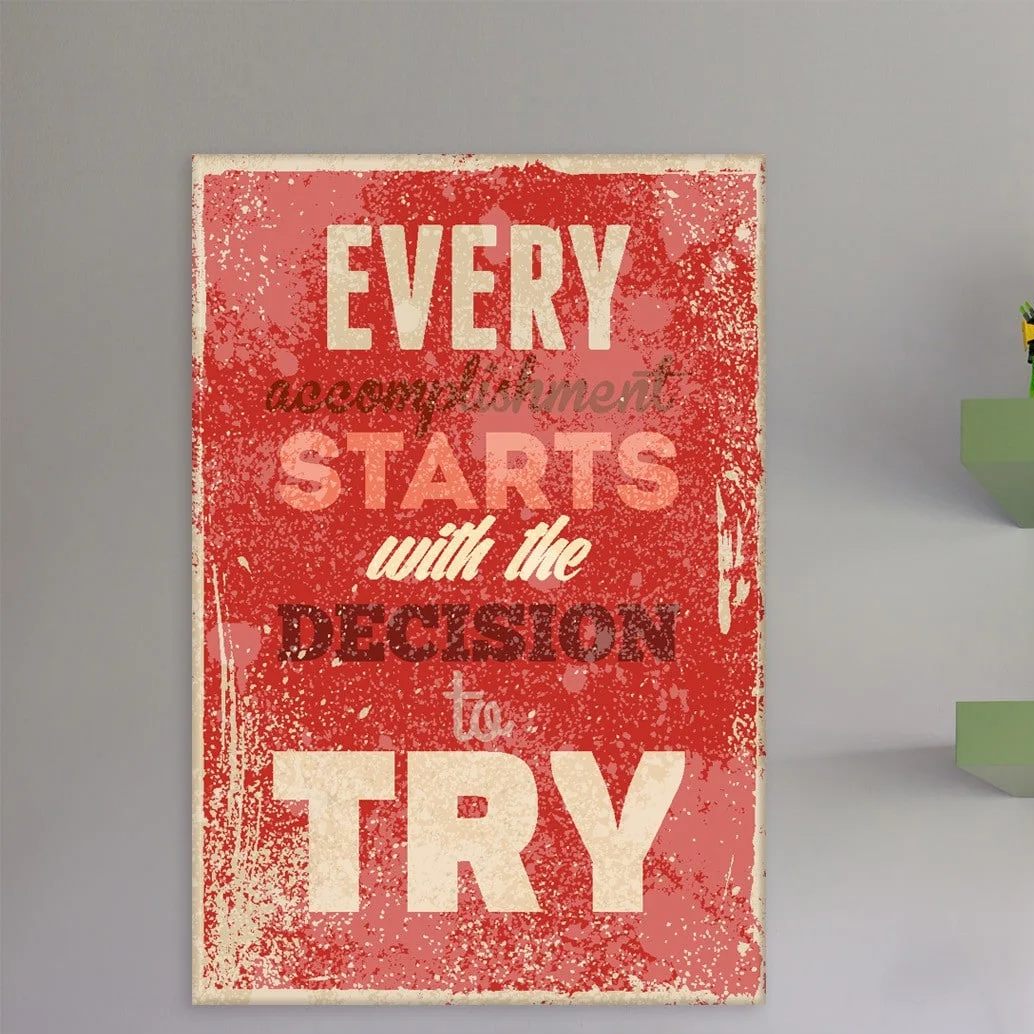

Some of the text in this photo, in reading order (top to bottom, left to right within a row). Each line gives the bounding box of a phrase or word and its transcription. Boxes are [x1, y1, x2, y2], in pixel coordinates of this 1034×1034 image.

[326, 224, 631, 350] EVERY
[266, 353, 692, 438] accomplishment
[278, 431, 679, 511] STARTS
[367, 515, 593, 582] with the
[277, 603, 681, 663] DECISION
[443, 669, 515, 743] to
[273, 750, 686, 913] TRY
